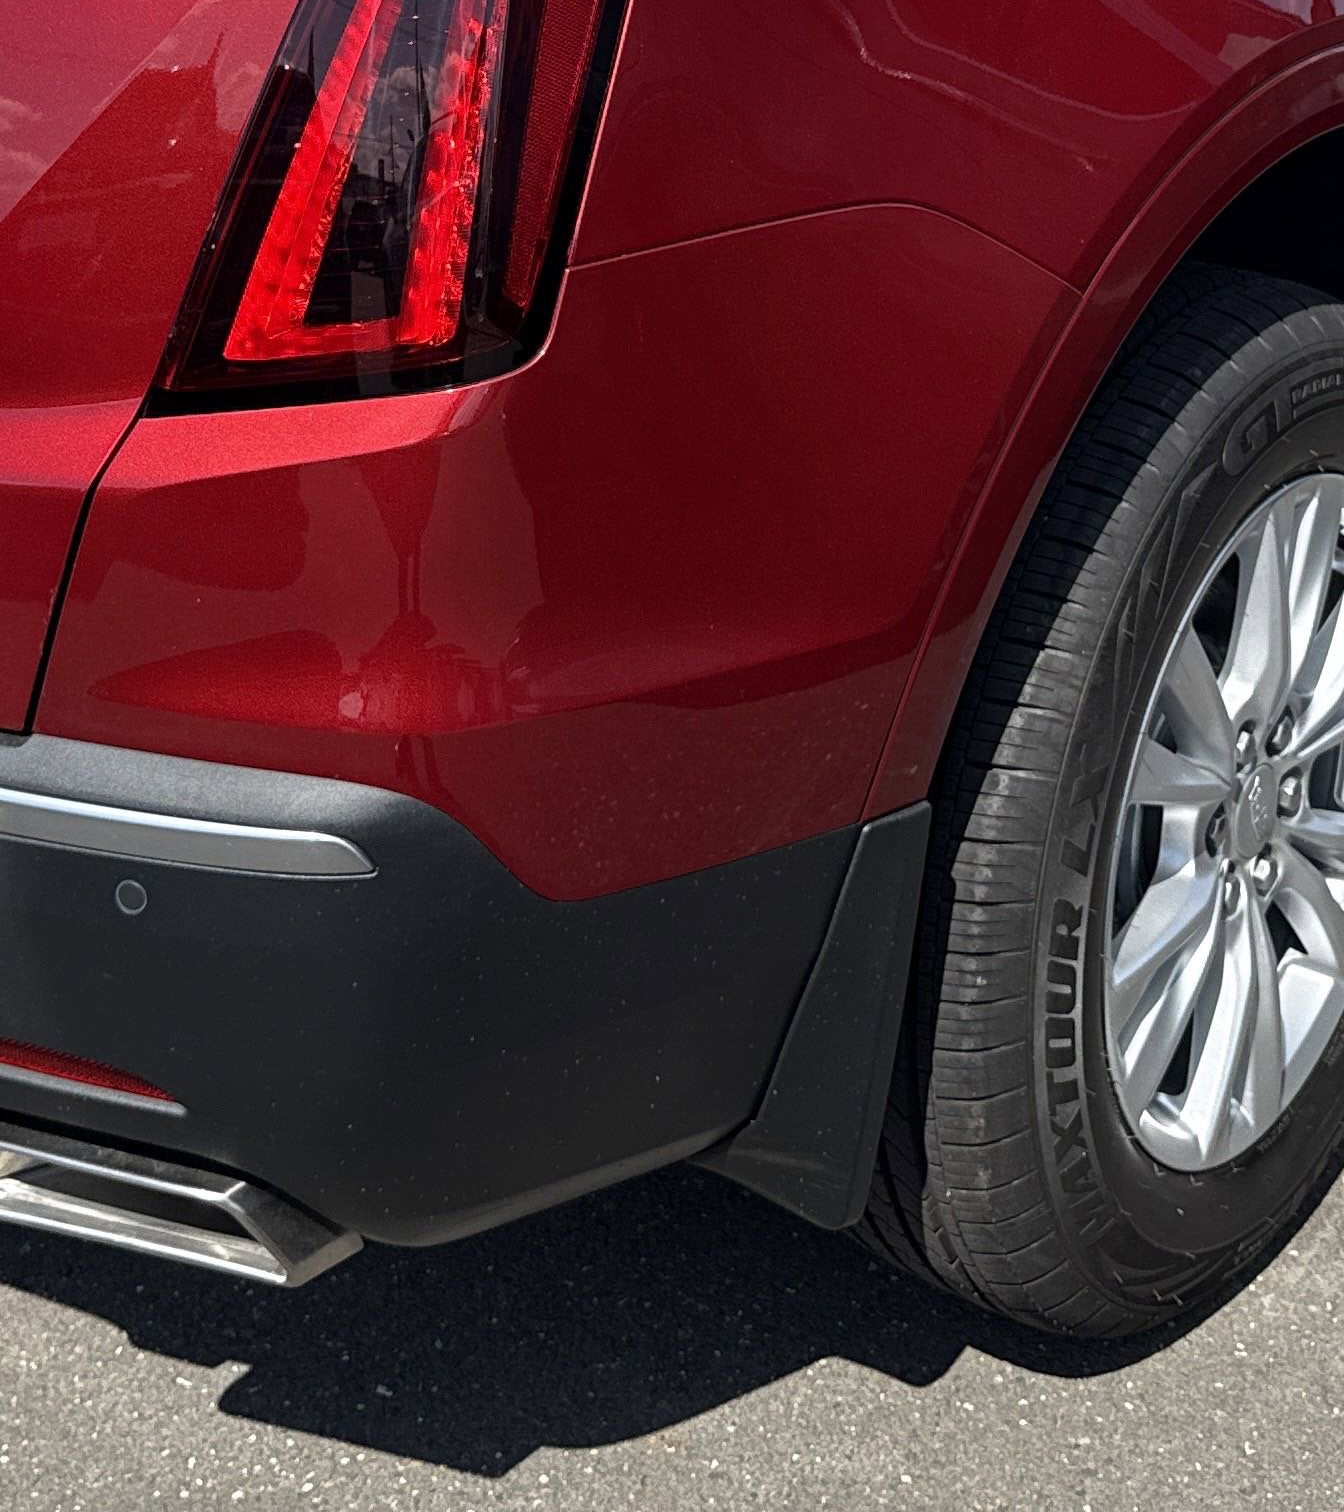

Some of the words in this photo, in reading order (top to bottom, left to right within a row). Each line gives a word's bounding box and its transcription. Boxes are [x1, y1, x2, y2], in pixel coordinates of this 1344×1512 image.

[1222, 357, 1344, 476] GT
[1291, 372, 1344, 404] RADIAL
[1045, 897, 1114, 1240] MAXTOUR
